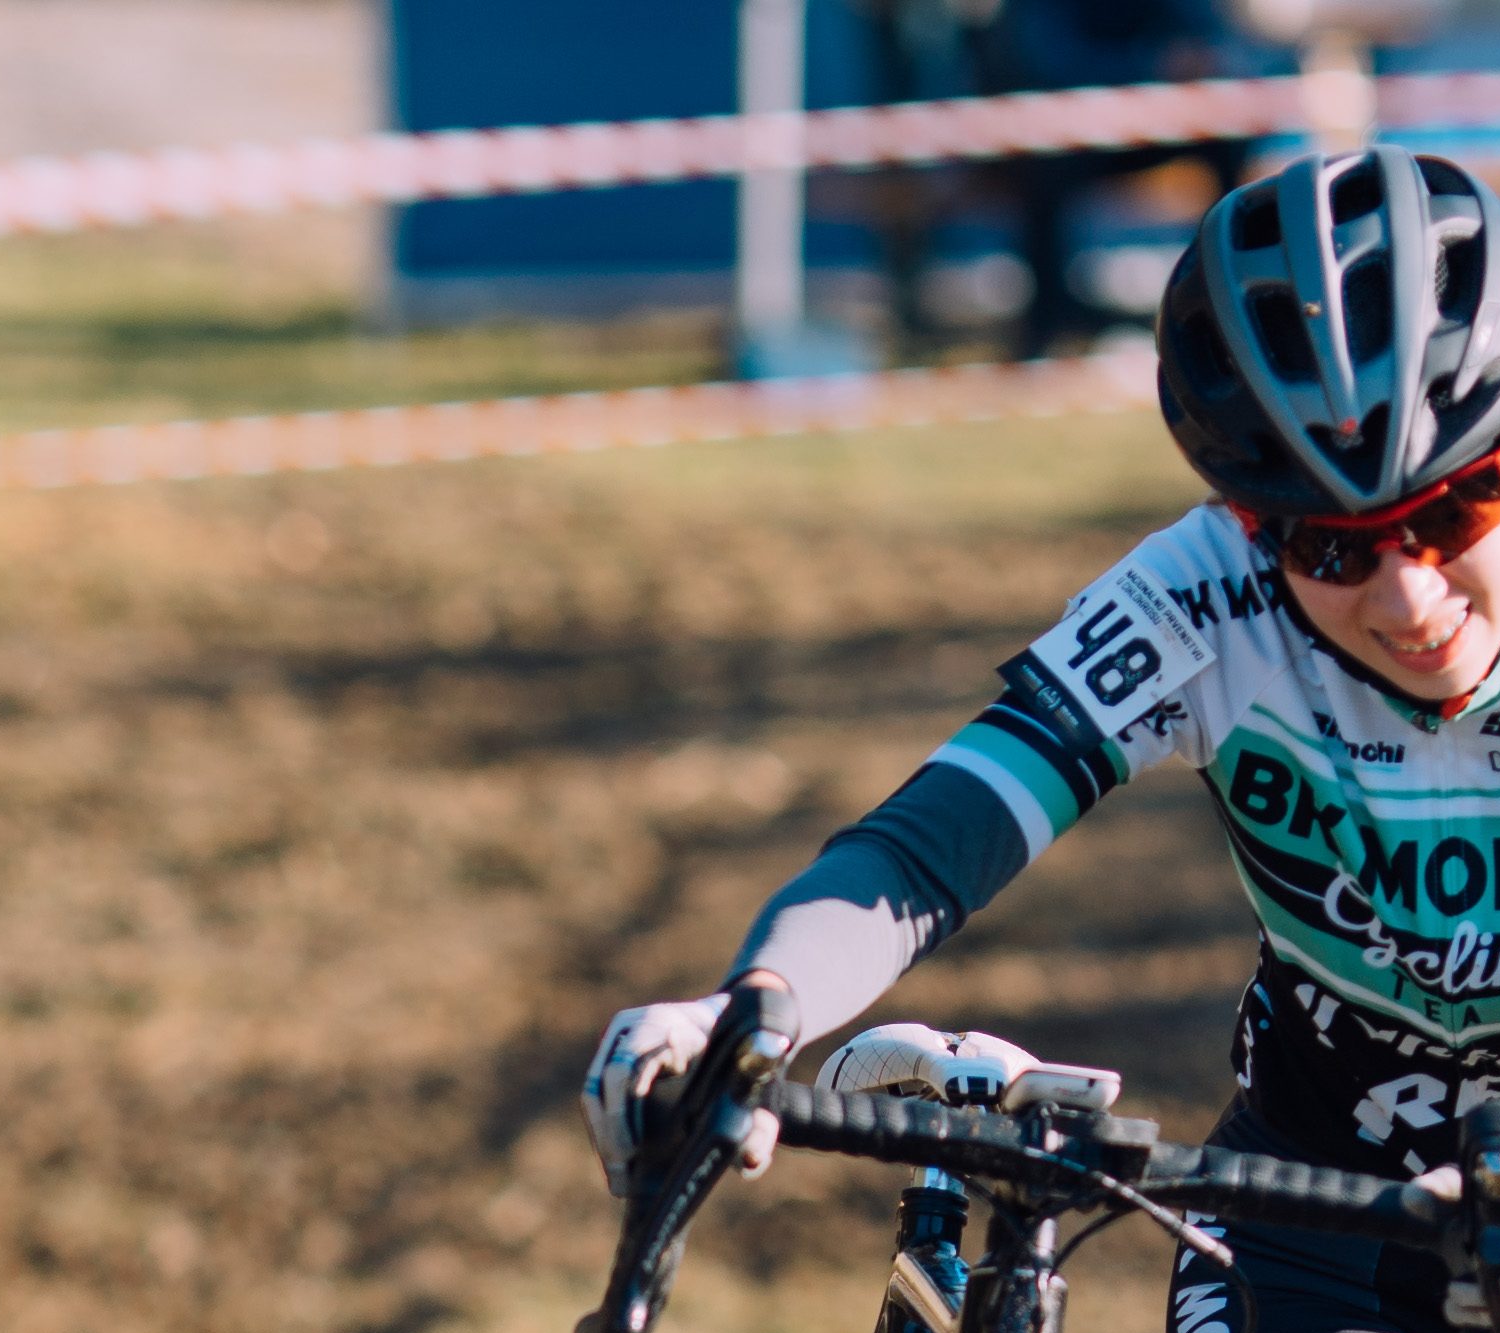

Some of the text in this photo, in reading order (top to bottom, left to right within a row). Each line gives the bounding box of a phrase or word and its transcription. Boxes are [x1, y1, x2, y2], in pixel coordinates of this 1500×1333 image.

[1067, 599, 1162, 707] 48
[1163, 608, 1204, 661] PRVENSTVO
[1229, 749, 1347, 854] BK
